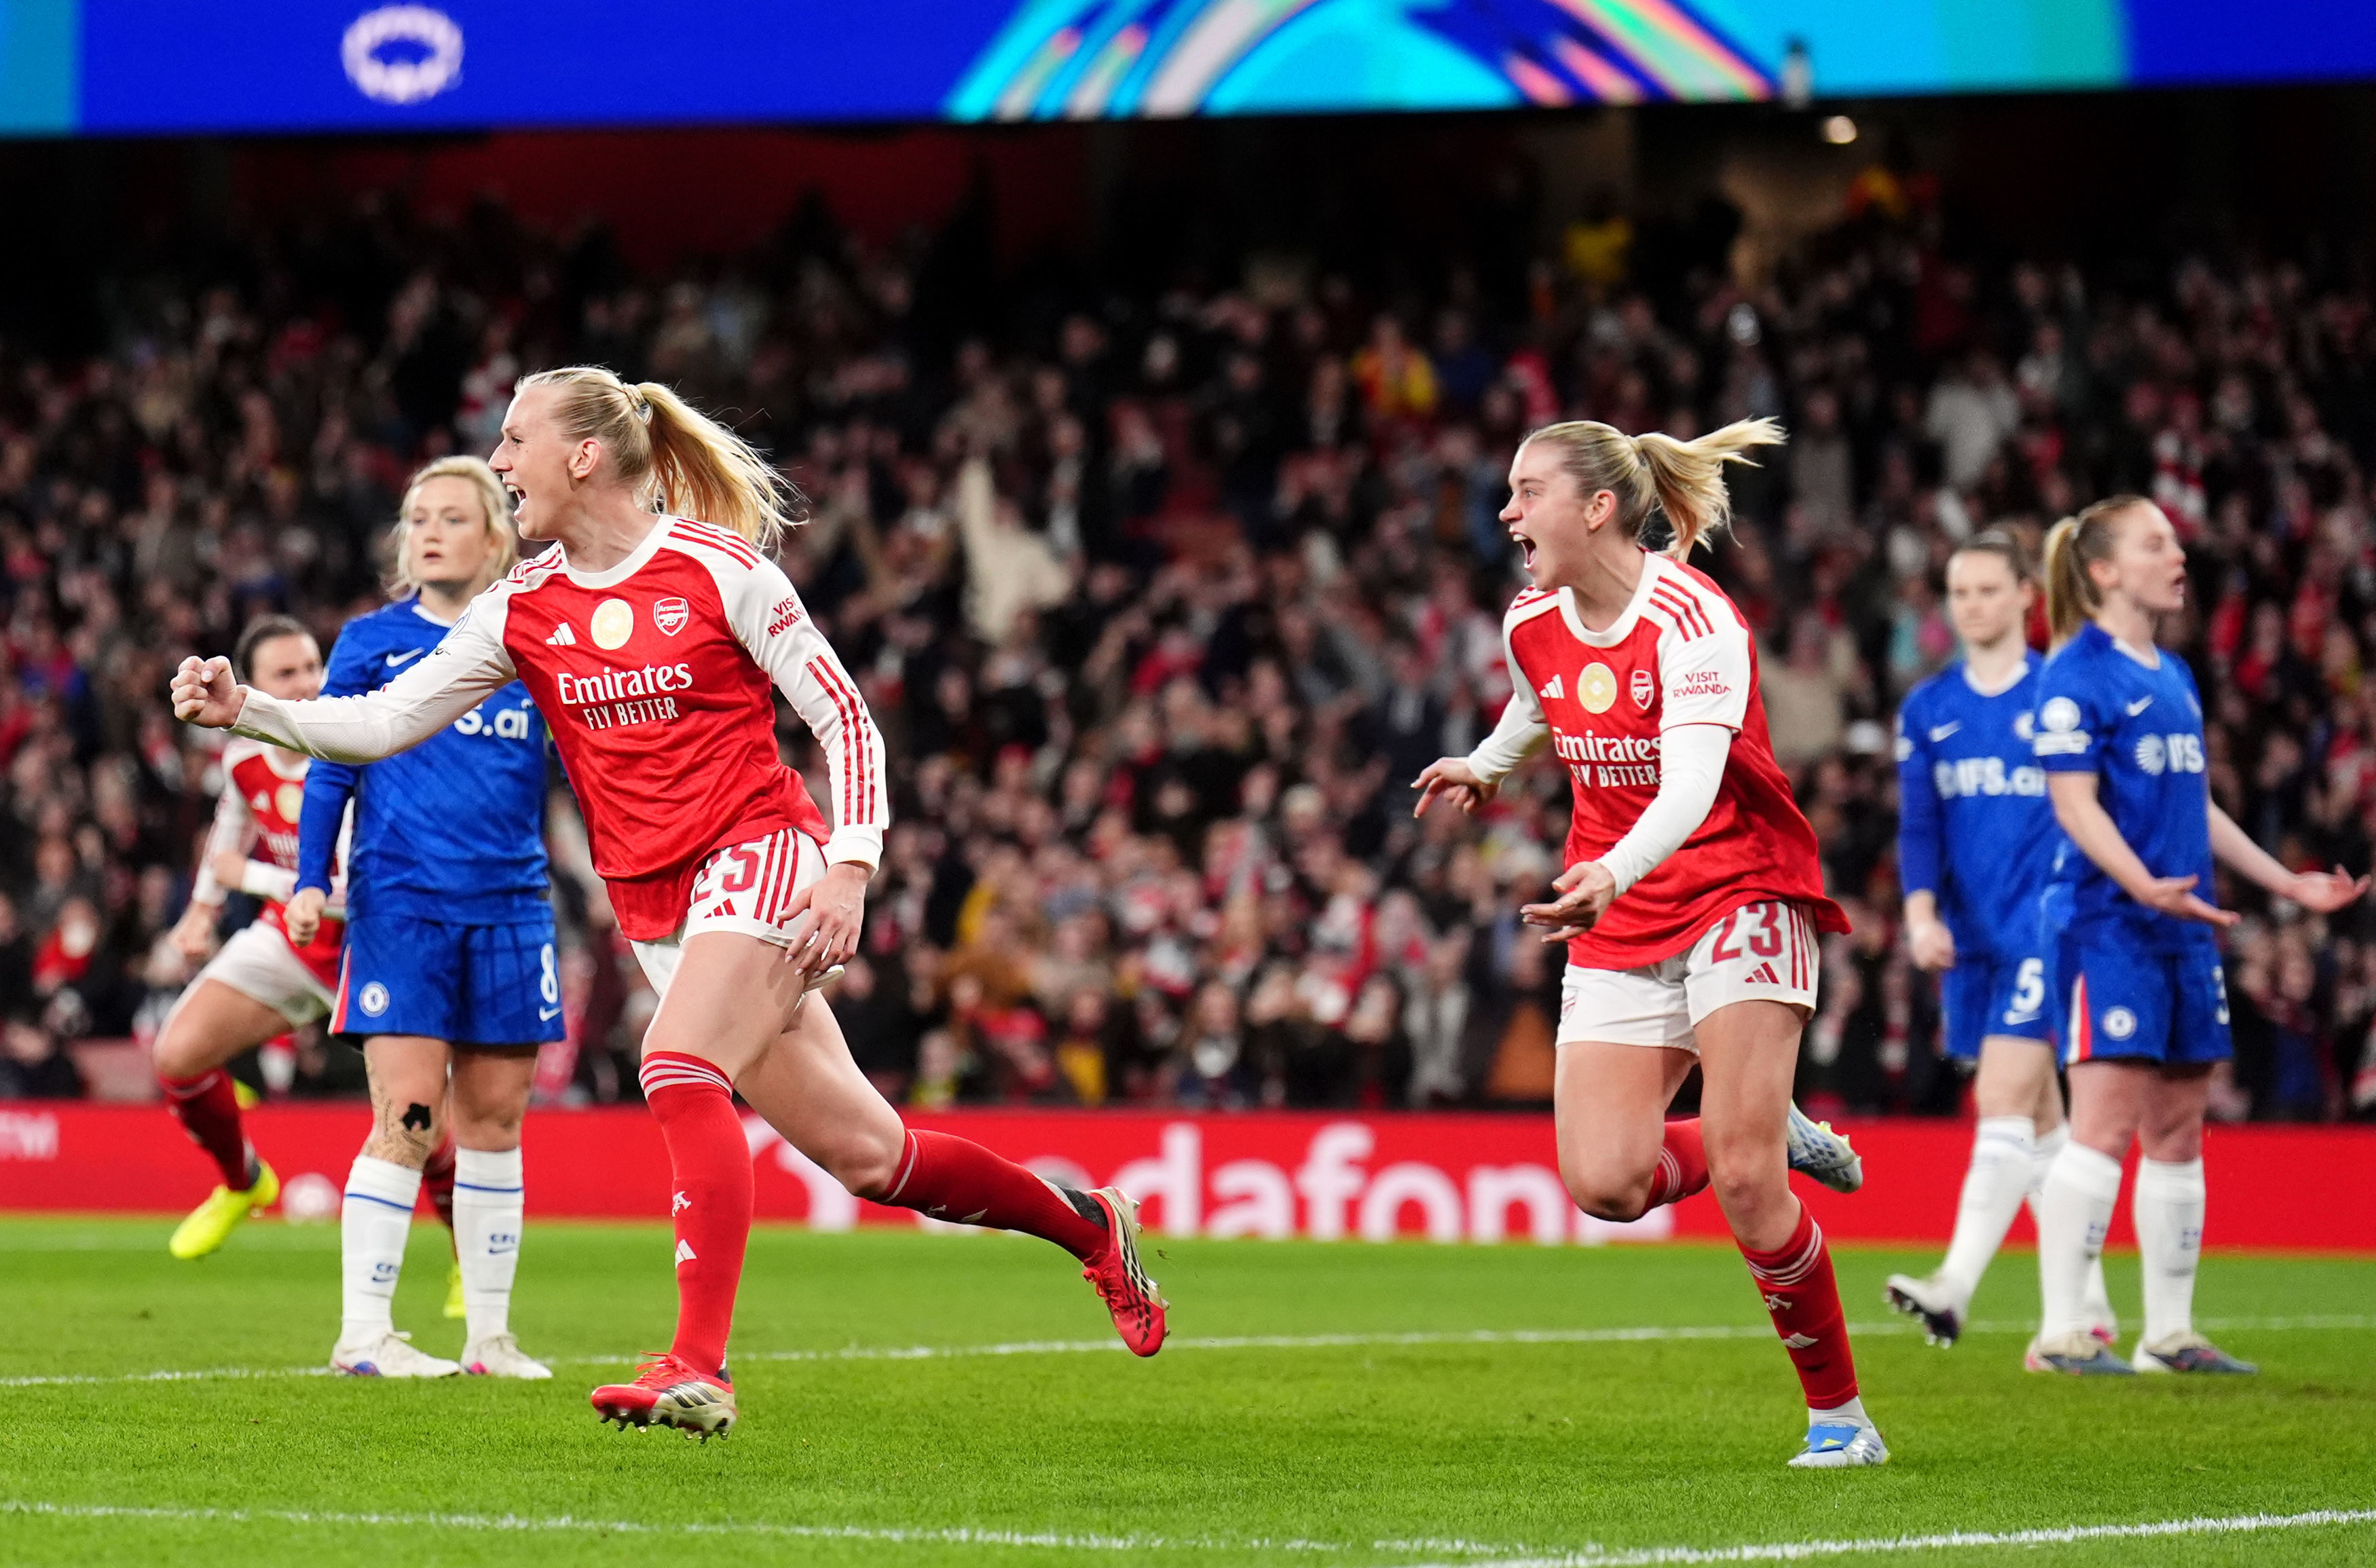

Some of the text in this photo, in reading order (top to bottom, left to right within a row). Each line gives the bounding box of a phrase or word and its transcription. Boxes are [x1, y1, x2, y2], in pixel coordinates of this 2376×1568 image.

[557, 663, 692, 705] Emirates
[1673, 684, 1732, 698] RWANDA
[1685, 671, 1719, 684] VISIT
[583, 696, 679, 730] FLY BETTER
[1552, 726, 1661, 762] Emirates
[1597, 764, 1660, 787] BETTER
[1712, 901, 1783, 964] 23
[540, 942, 559, 1004] 8
[2011, 957, 2045, 1013] 5
[913, 1120, 1675, 1246] dafon
